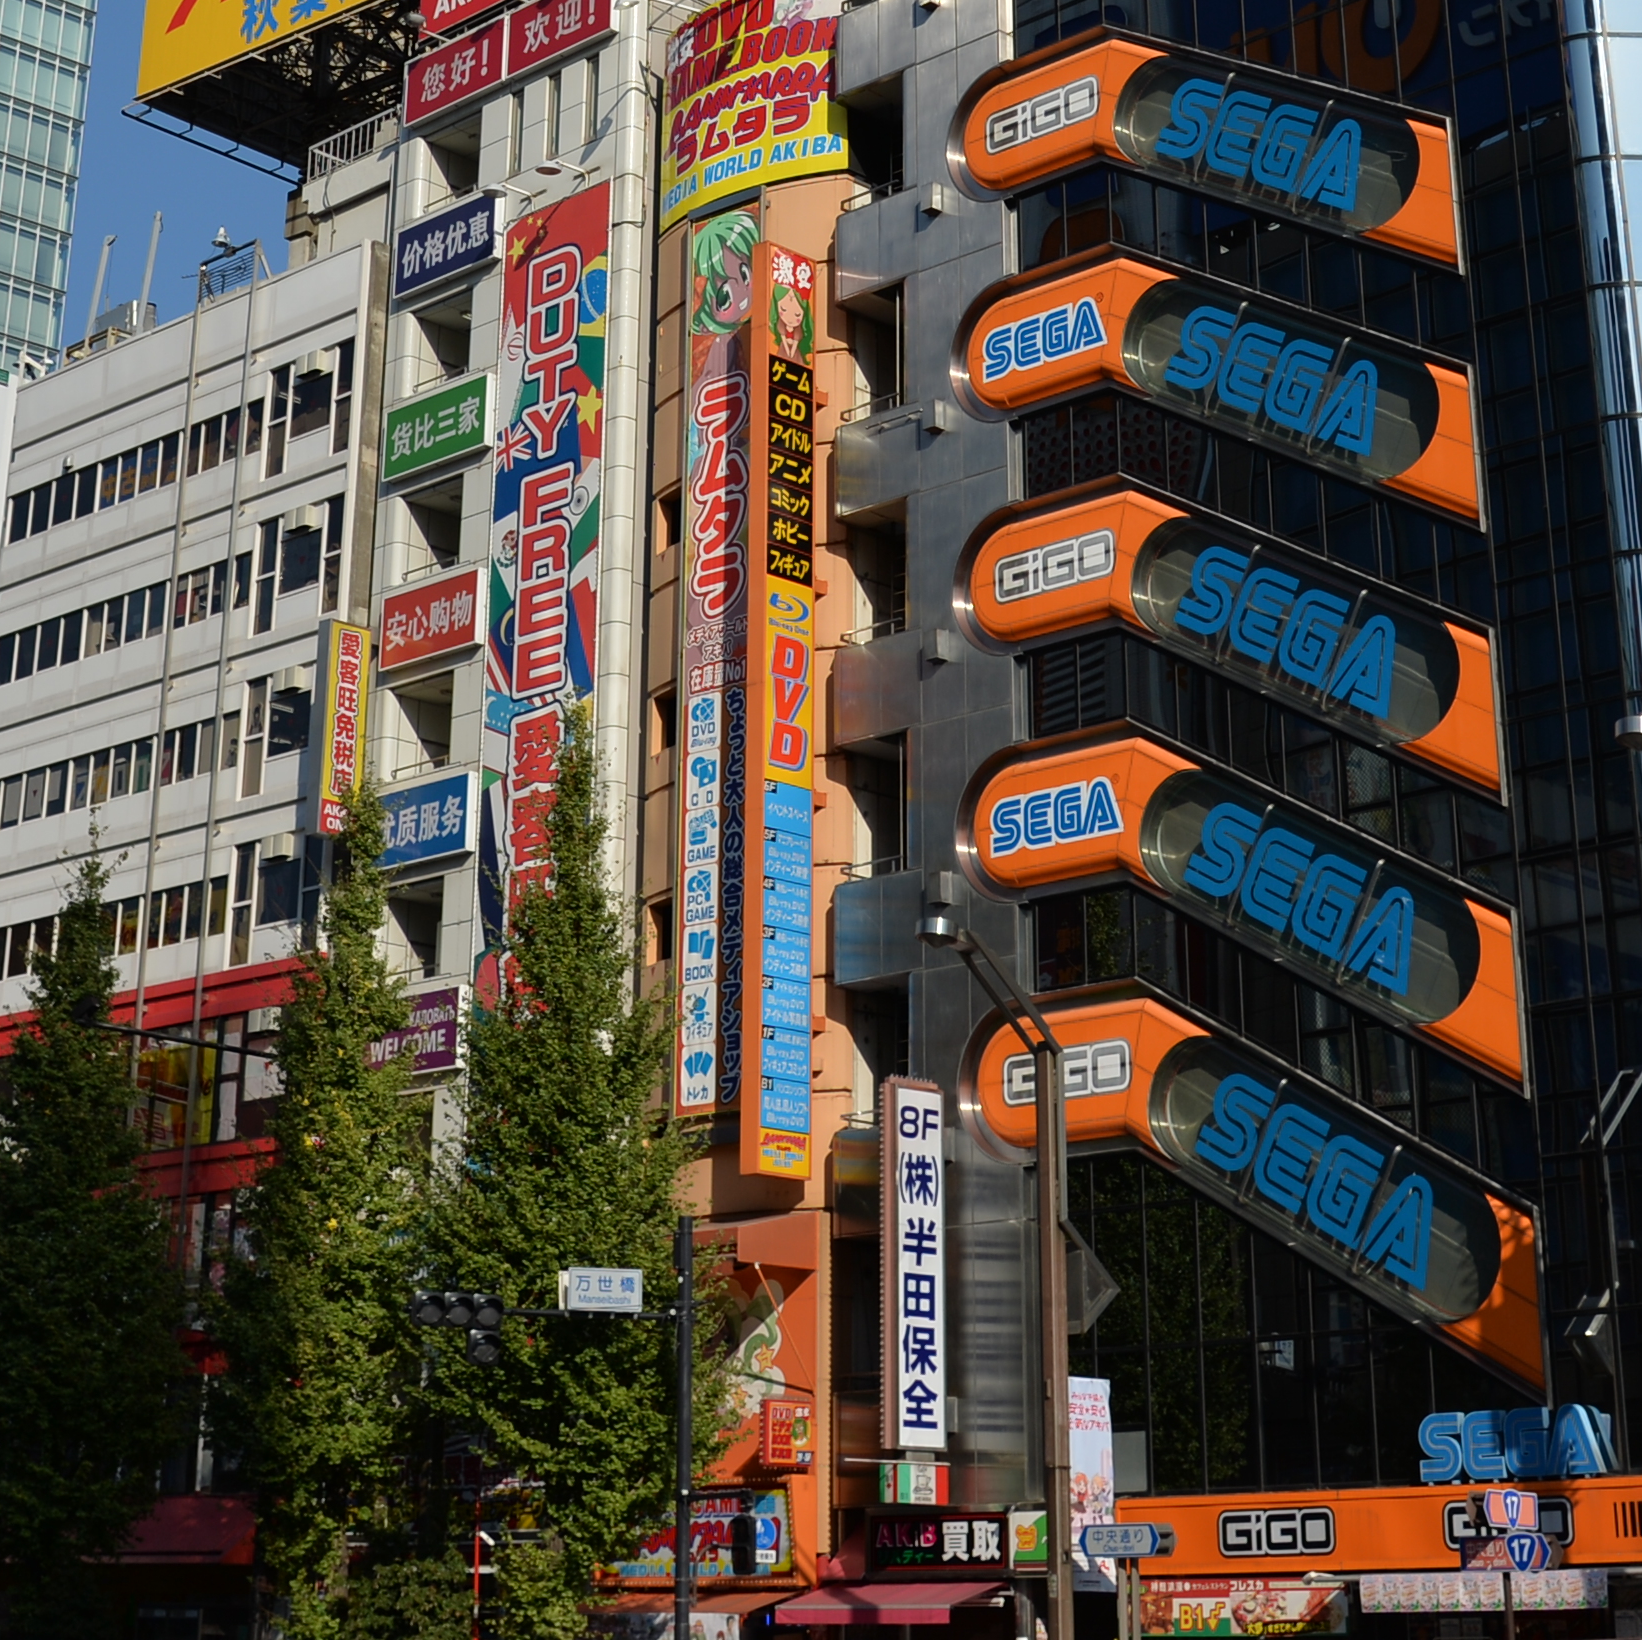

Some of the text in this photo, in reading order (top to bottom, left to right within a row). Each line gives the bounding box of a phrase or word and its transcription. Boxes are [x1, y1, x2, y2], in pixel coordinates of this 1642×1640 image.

[420, 39, 491, 103] 您好!
[676, 95, 812, 177] ラムタラ
[1155, 76, 1363, 213] SEGA
[663, 132, 843, 212] MEDIA WORLD AKIBA
[401, 210, 491, 280] 价格优惠
[982, 296, 1108, 384] SEGA
[772, 360, 811, 394] ゲーム
[1163, 305, 1380, 457] SEGA
[775, 394, 806, 422] CD
[390, 396, 481, 462] 货比三家
[770, 422, 812, 454] アイドル
[512, 244, 583, 701] DUTY FREE
[770, 453, 812, 486] アニメ
[690, 369, 750, 622] ラムタラ
[770, 487, 811, 518] コミック
[772, 517, 810, 545] ホビー
[385, 589, 474, 651] 安心购物
[1174, 544, 1398, 722] SEGA
[768, 633, 810, 772] DVD
[691, 723, 716, 739] DVD
[988, 776, 1126, 859] SEGA
[687, 846, 716, 863] GAME
[686, 905, 716, 923] GAME
[687, 892, 703, 908] PC
[1182, 801, 1415, 998] SEGA
[685, 964, 714, 983] BOOK
[686, 1085, 709, 1102] トレカ
[1194, 1072, 1434, 1292] SEGA
[573, 1275, 637, 1296] 万世橋
[898, 1107, 940, 1431] 8F (株)半田保全
[576, 1293, 633, 1307] Manseibashi
[1419, 1403, 1613, 1484] SEGA
[1505, 1495, 1518, 1513] 17
[941, 1520, 1002, 1563] 買取
[1092, 1529, 1145, 1545] 中央通り
[1102, 1544, 1135, 1554] Chuo-dori
[1465, 1540, 1505, 1558] 中央通り
[1509, 1538, 1531, 1563] 17
[1229, 1579, 1265, 1592] フレスカ
[1179, 1603, 1204, 1632] B1
